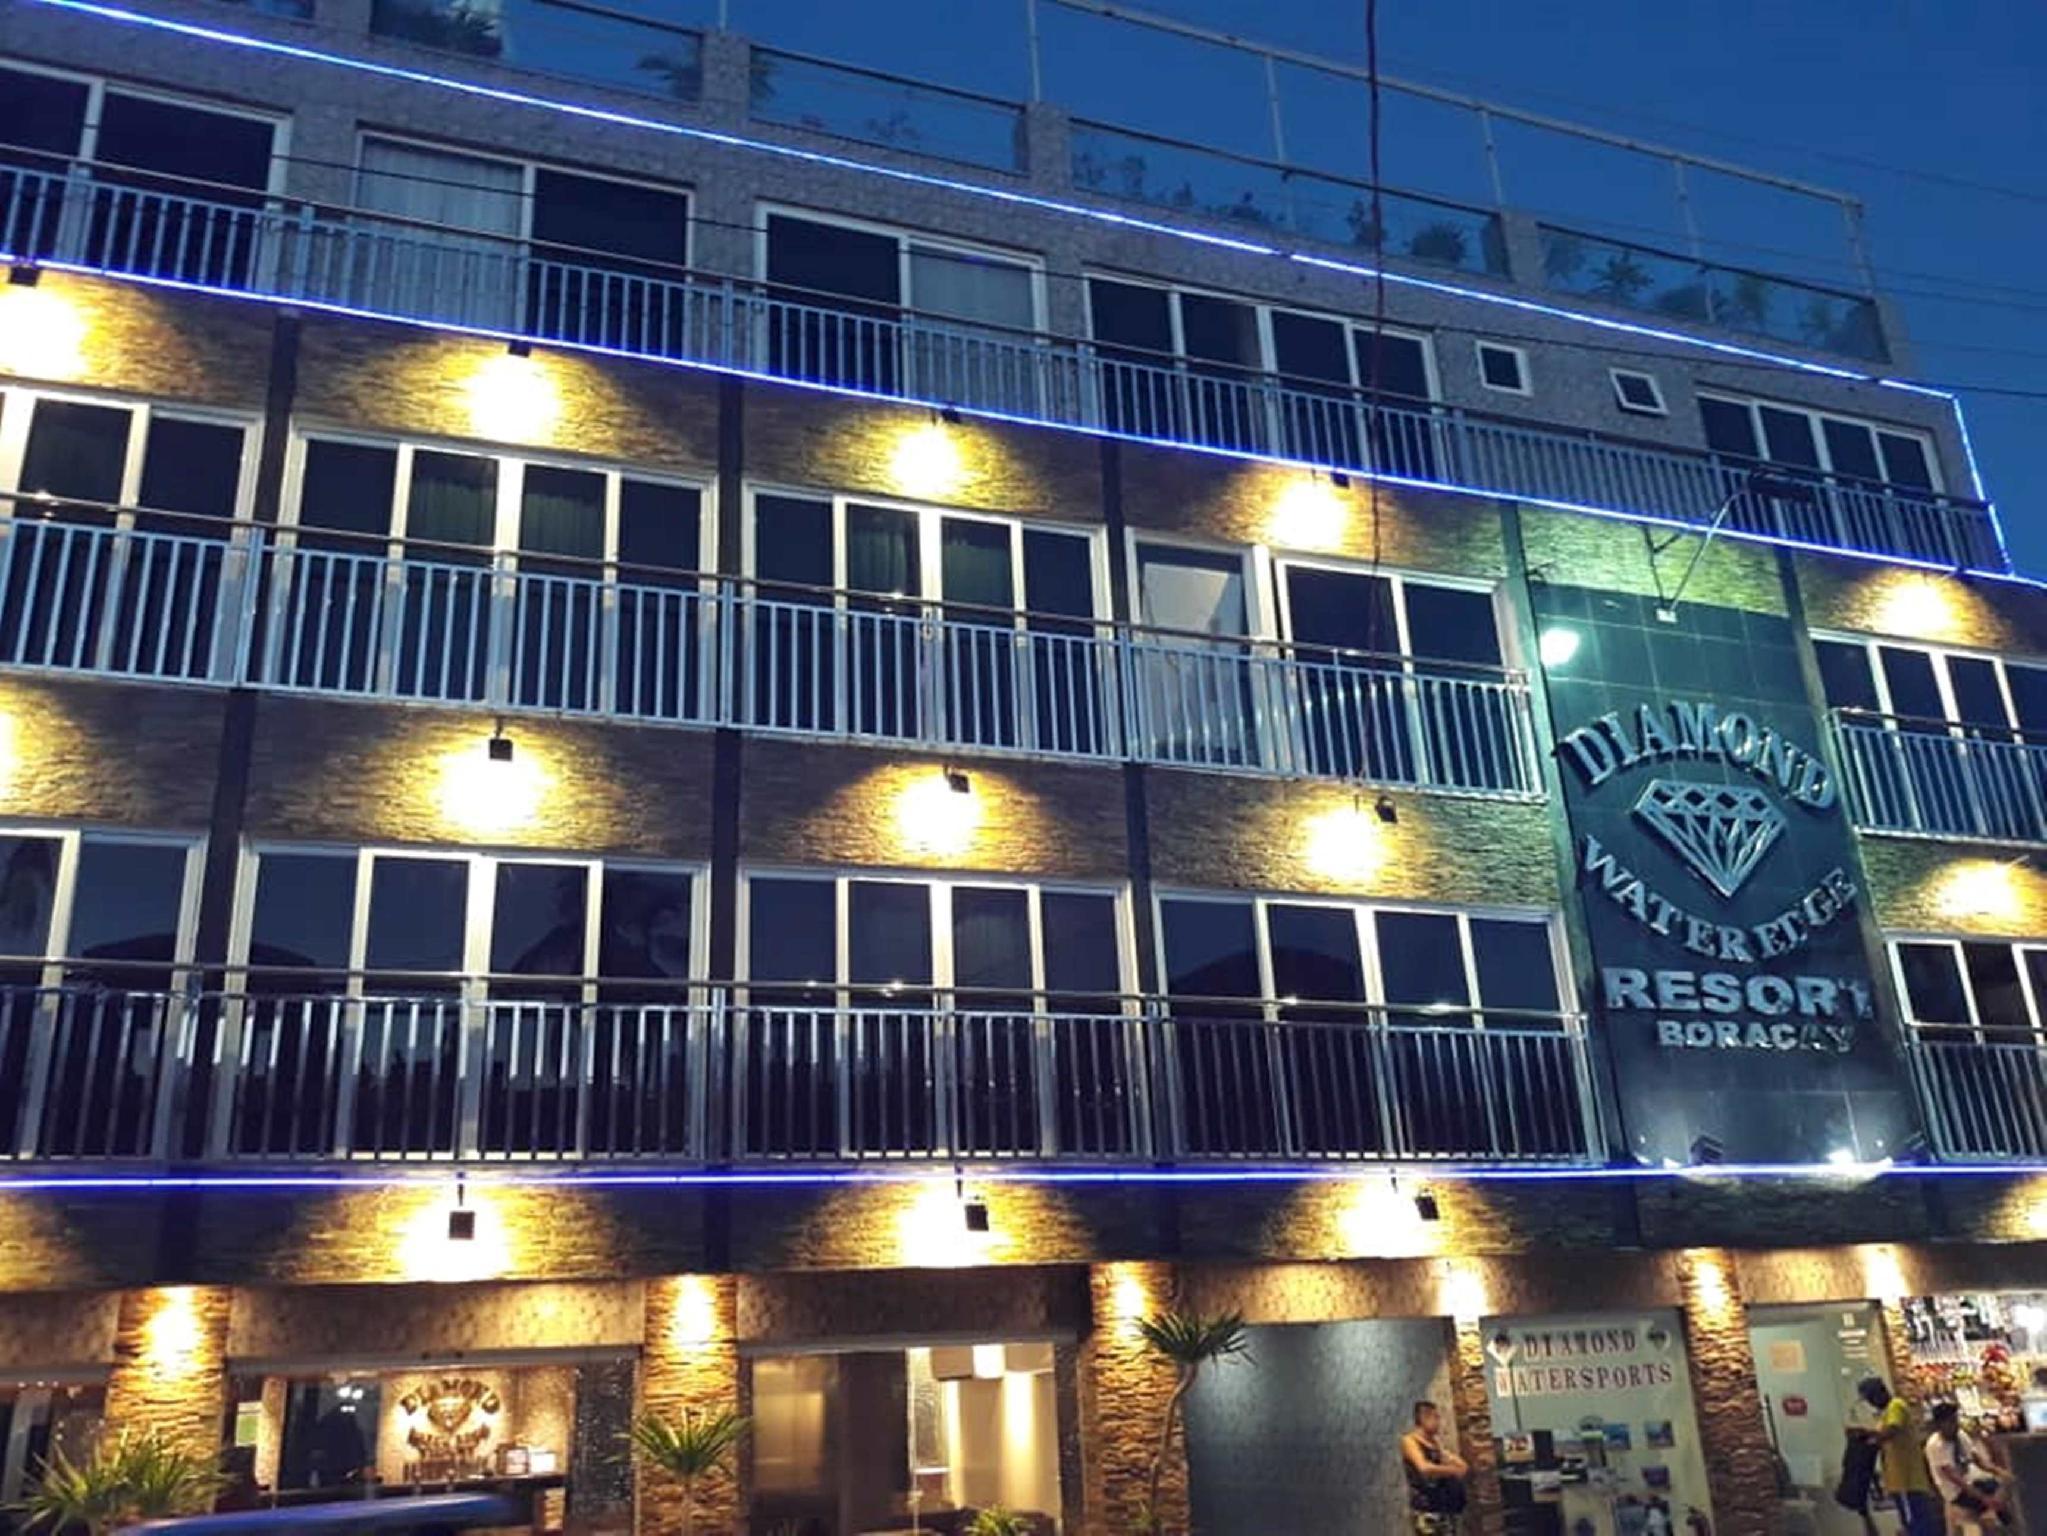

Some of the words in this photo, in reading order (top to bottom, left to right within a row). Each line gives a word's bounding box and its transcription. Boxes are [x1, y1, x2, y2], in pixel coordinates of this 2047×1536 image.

[1557, 701, 1838, 809] DIAMOND
[1602, 966, 1874, 1019] RESORT
[1657, 1019, 1854, 1052] BORACAY
[1522, 1328, 1636, 1360] DIAMOND
